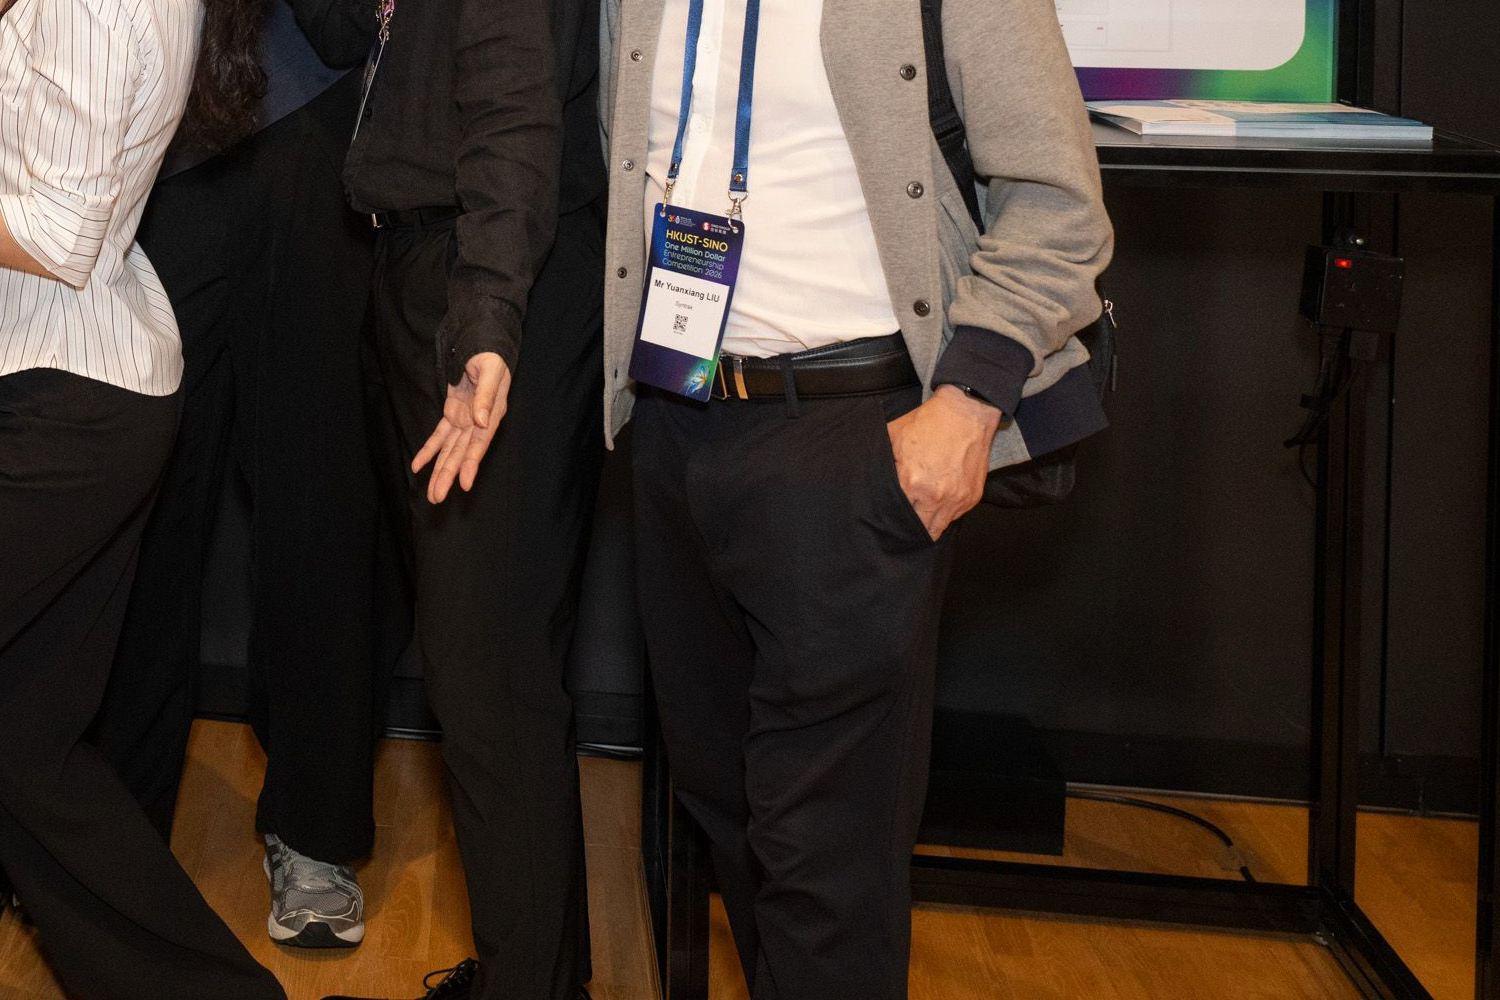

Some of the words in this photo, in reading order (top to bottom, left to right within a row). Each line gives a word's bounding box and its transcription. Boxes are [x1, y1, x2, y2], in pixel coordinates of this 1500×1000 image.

[666, 229, 728, 252] HKUST-SINO
[664, 249, 724, 270] Entrepreneurship
[665, 242, 678, 250] One
[681, 245, 703, 256] Million
[705, 251, 726, 262] Dollar
[662, 258, 703, 274] Competition
[705, 269, 722, 278] 2026
[654, 280, 664, 288] Mr
[667, 282, 705, 300] Yuanxiang
[706, 293, 720, 302] LIU
